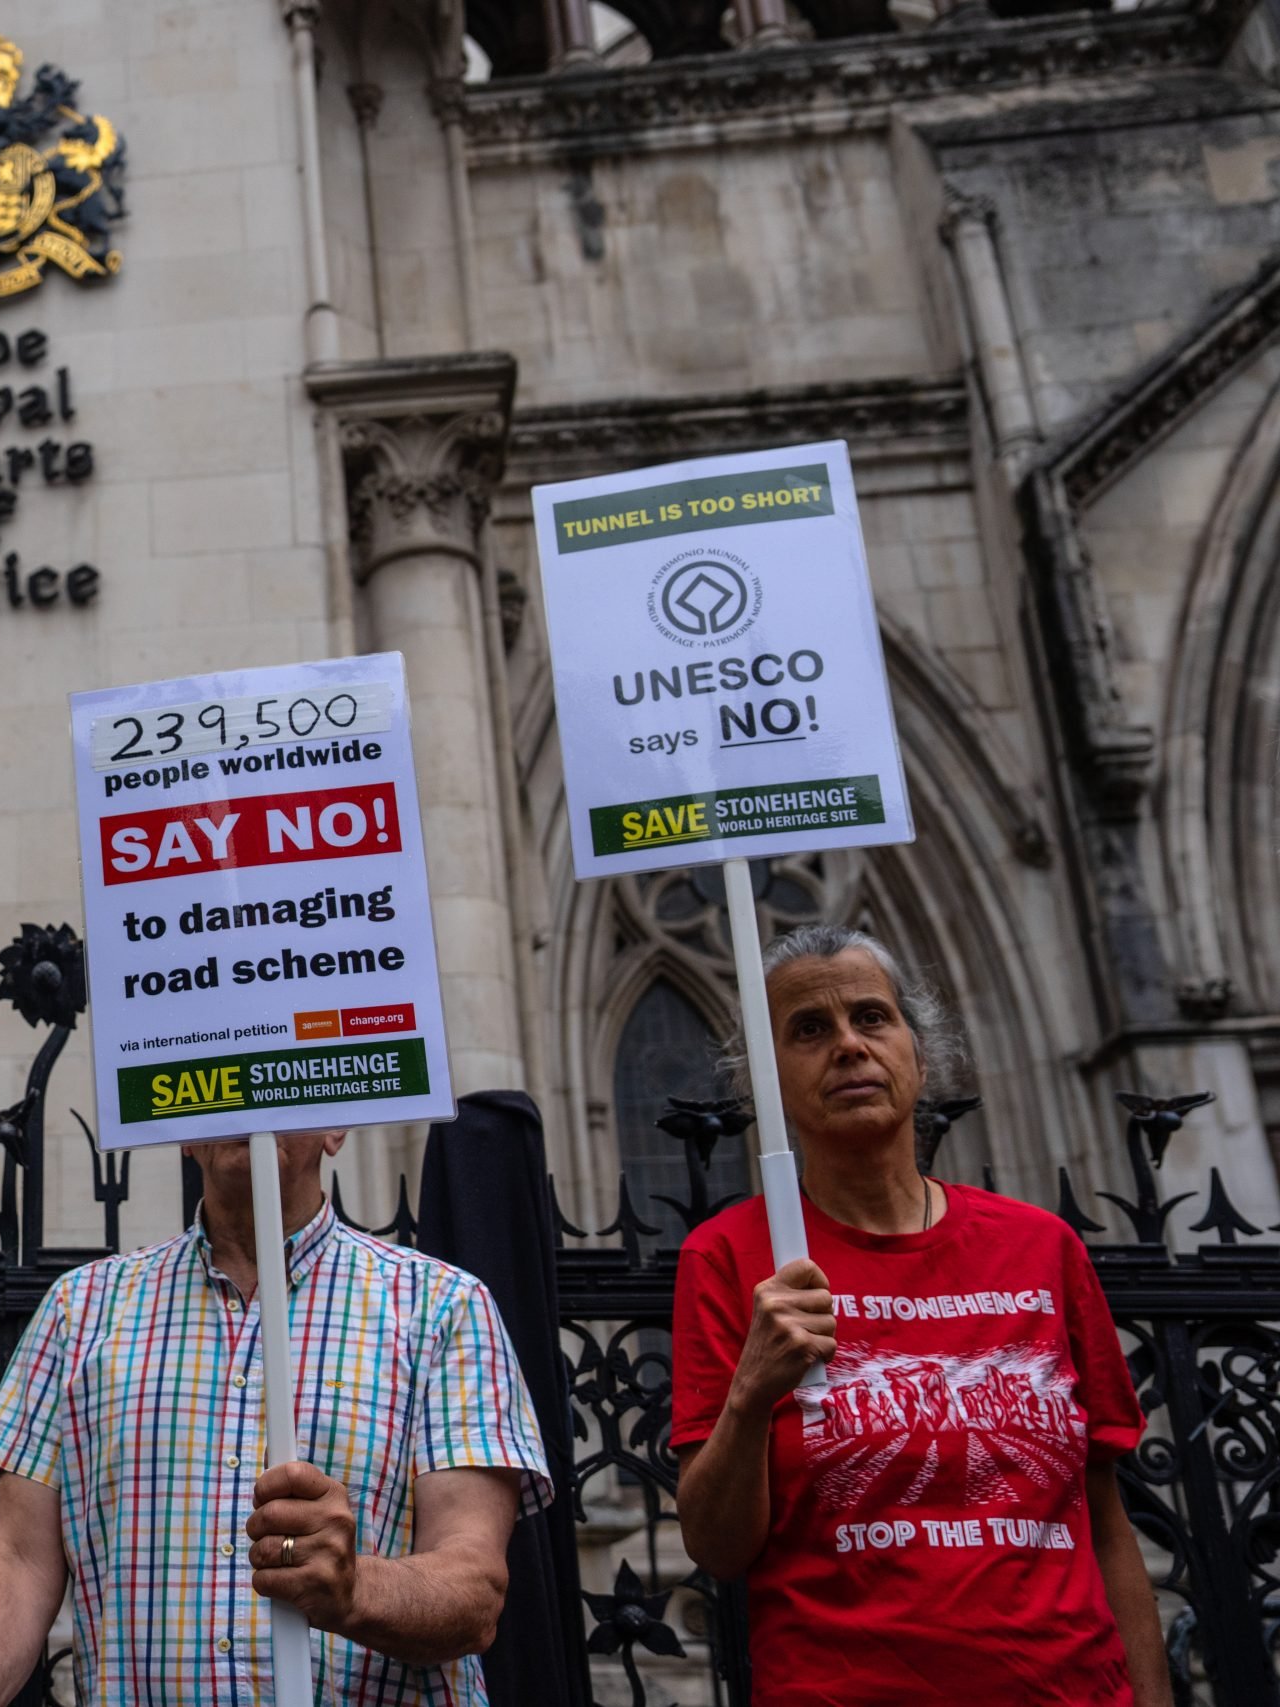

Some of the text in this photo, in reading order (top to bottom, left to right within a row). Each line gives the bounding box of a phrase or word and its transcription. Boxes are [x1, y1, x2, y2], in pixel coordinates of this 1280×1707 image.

[563, 486, 822, 538] TUNNEL IS TOO SHORT
[652, 548, 752, 585] PATRIMONIO MUNDIAL
[646, 591, 695, 648] WORLD HERITAGE
[703, 618, 756, 648] PATRIMOINE
[612, 649, 824, 706] UNESCO
[110, 693, 358, 762] 239,500
[629, 695, 820, 756] says NO!
[104, 738, 383, 797] people worldwide
[110, 797, 388, 872] SAY NO!
[622, 786, 857, 841] SAVE STONEHENGE
[718, 808, 858, 833] WORLD HERITAGE SITE
[123, 884, 396, 942] to damaging
[124, 944, 406, 999] road scheme
[120, 1022, 288, 1052] via international petition
[349, 1012, 404, 1027] change.org
[151, 1052, 401, 1108] SAVE STONEHENGE
[252, 1078, 402, 1102] WORLD HERITAGE SITE
[831, 1289, 1056, 1320] VE STONEHENGE
[836, 1520, 916, 1552] STOP
[922, 1520, 984, 1548] THE
